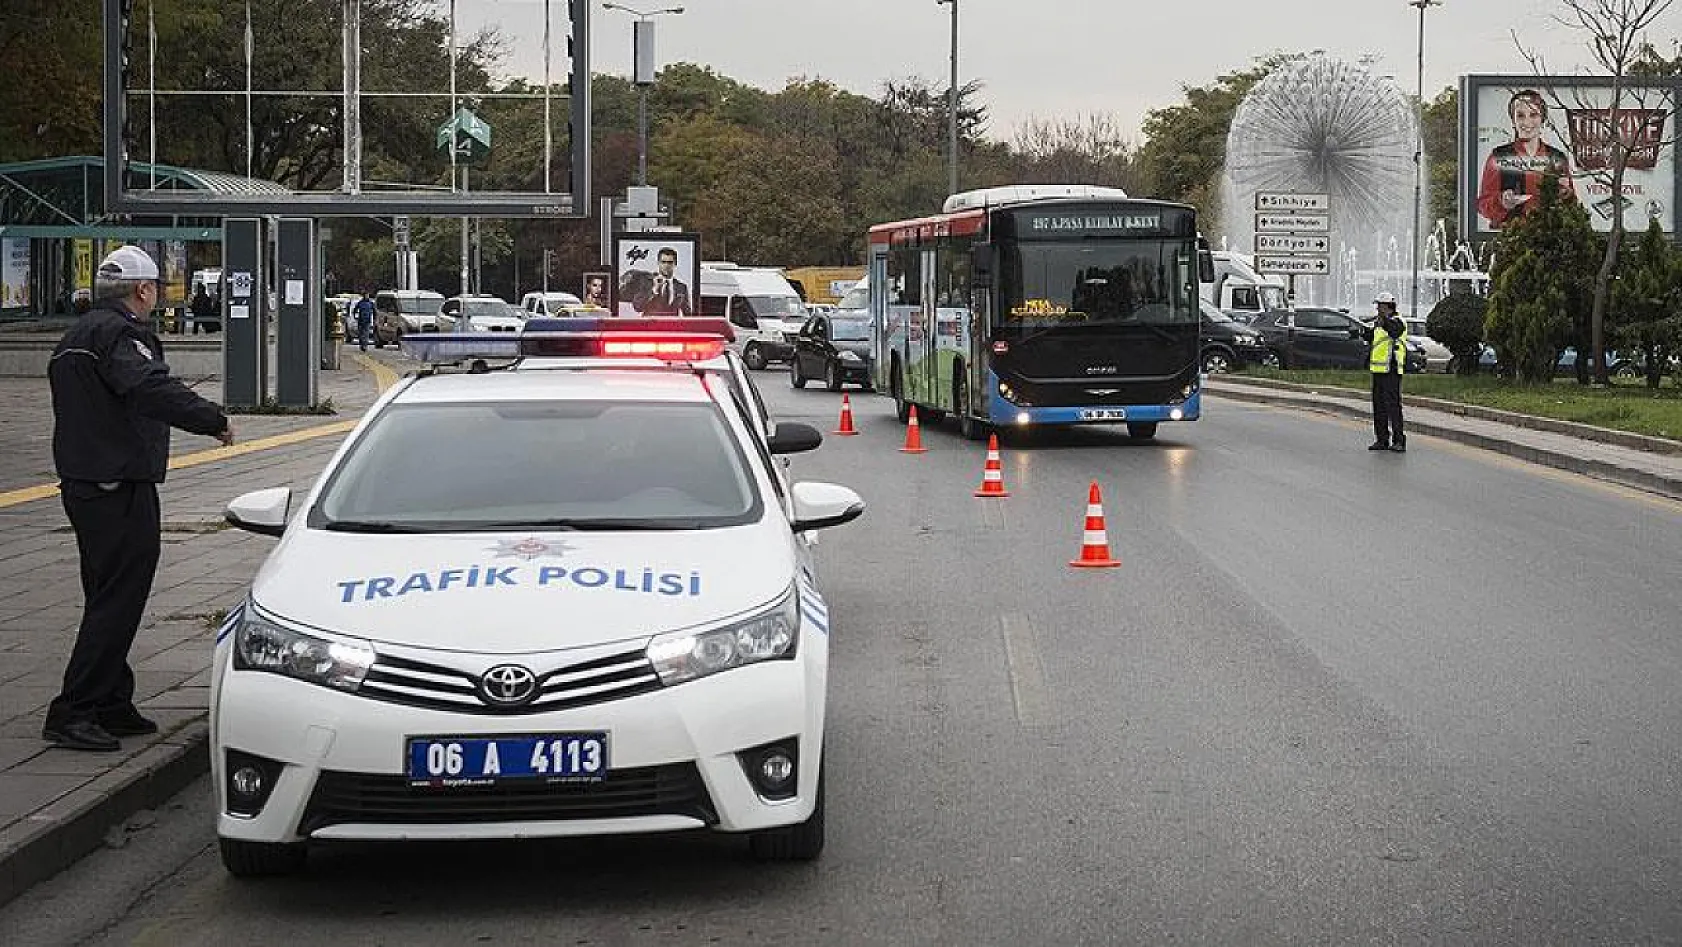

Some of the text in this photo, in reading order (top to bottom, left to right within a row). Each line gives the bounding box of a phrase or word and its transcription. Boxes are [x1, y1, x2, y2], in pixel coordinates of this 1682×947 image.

[337, 564, 700, 603] TRAFİK POLİSİ
[427, 739, 602, 777] 06 A 4113
